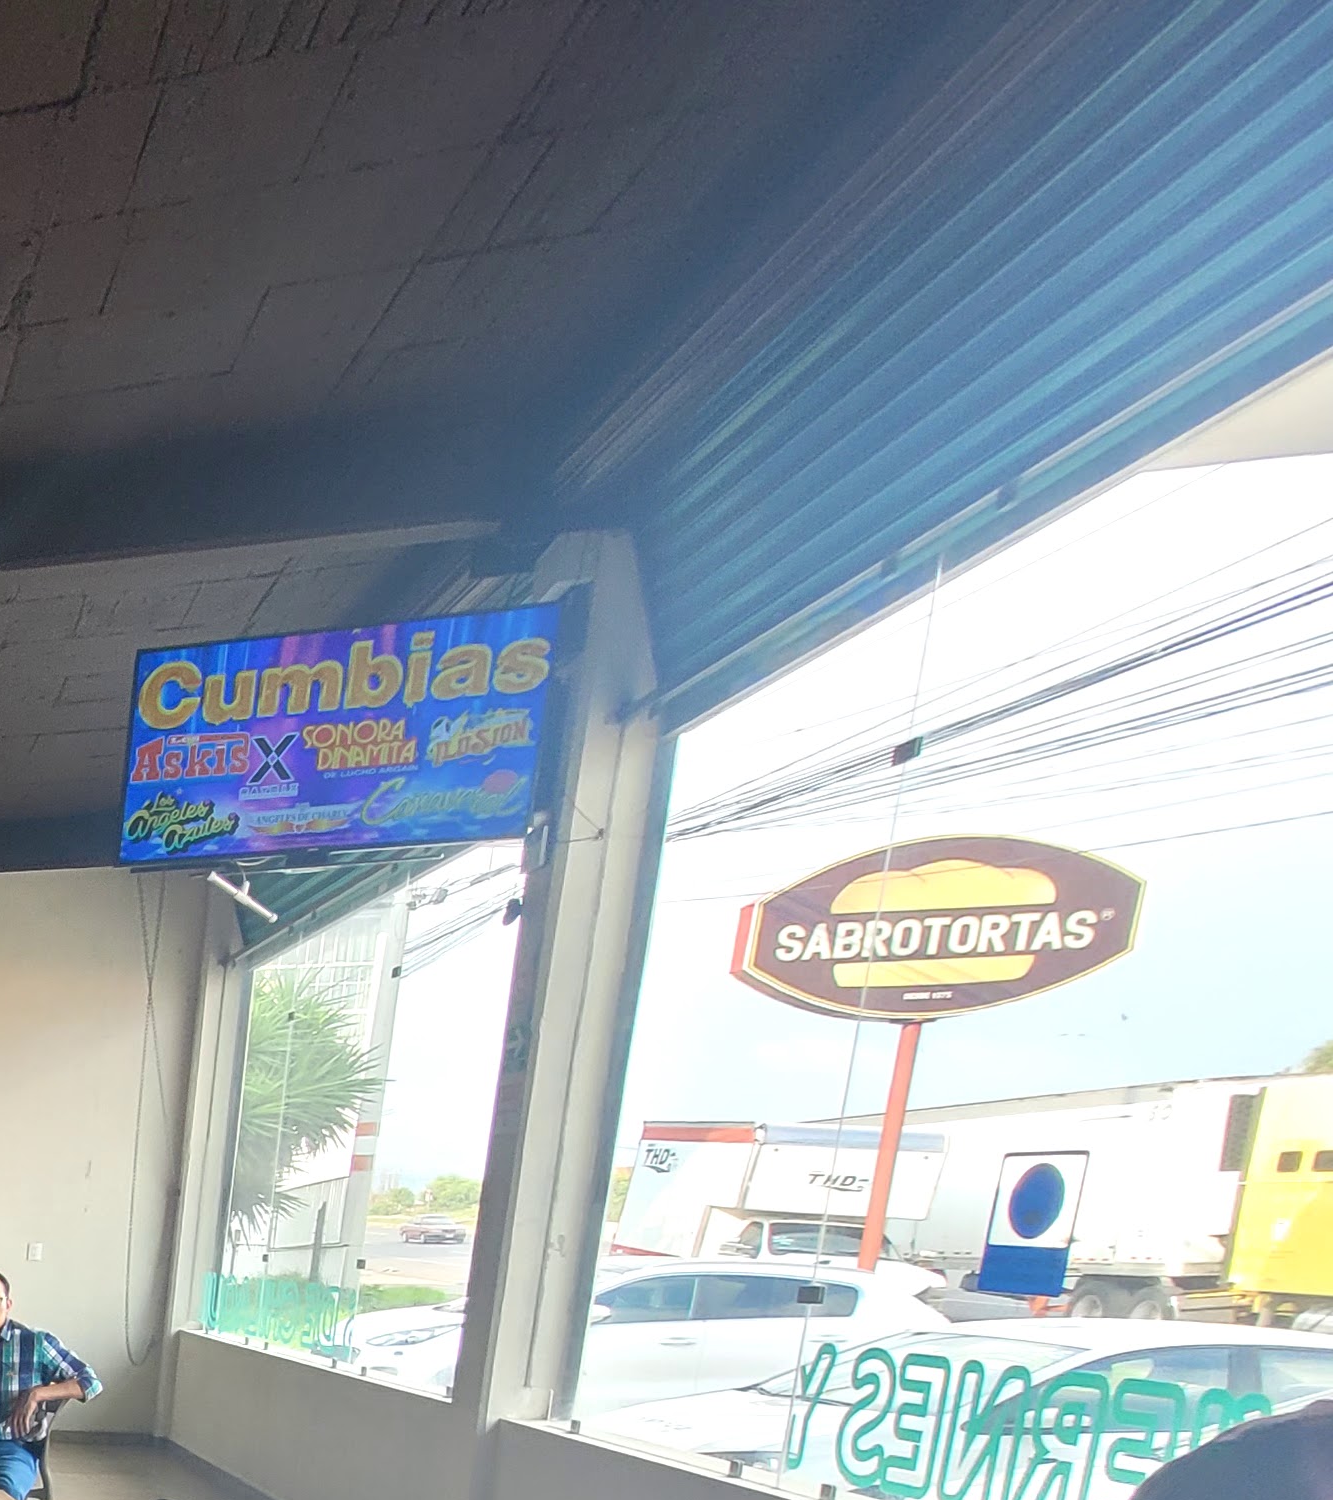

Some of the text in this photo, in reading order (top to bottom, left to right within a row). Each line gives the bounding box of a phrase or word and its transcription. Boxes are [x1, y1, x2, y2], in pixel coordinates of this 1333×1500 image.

[139, 631, 550, 730] Cumbias
[302, 718, 405, 748] SONORA
[317, 739, 417, 771] DINAMITA
[775, 909, 1097, 962] SABROTORTAS
